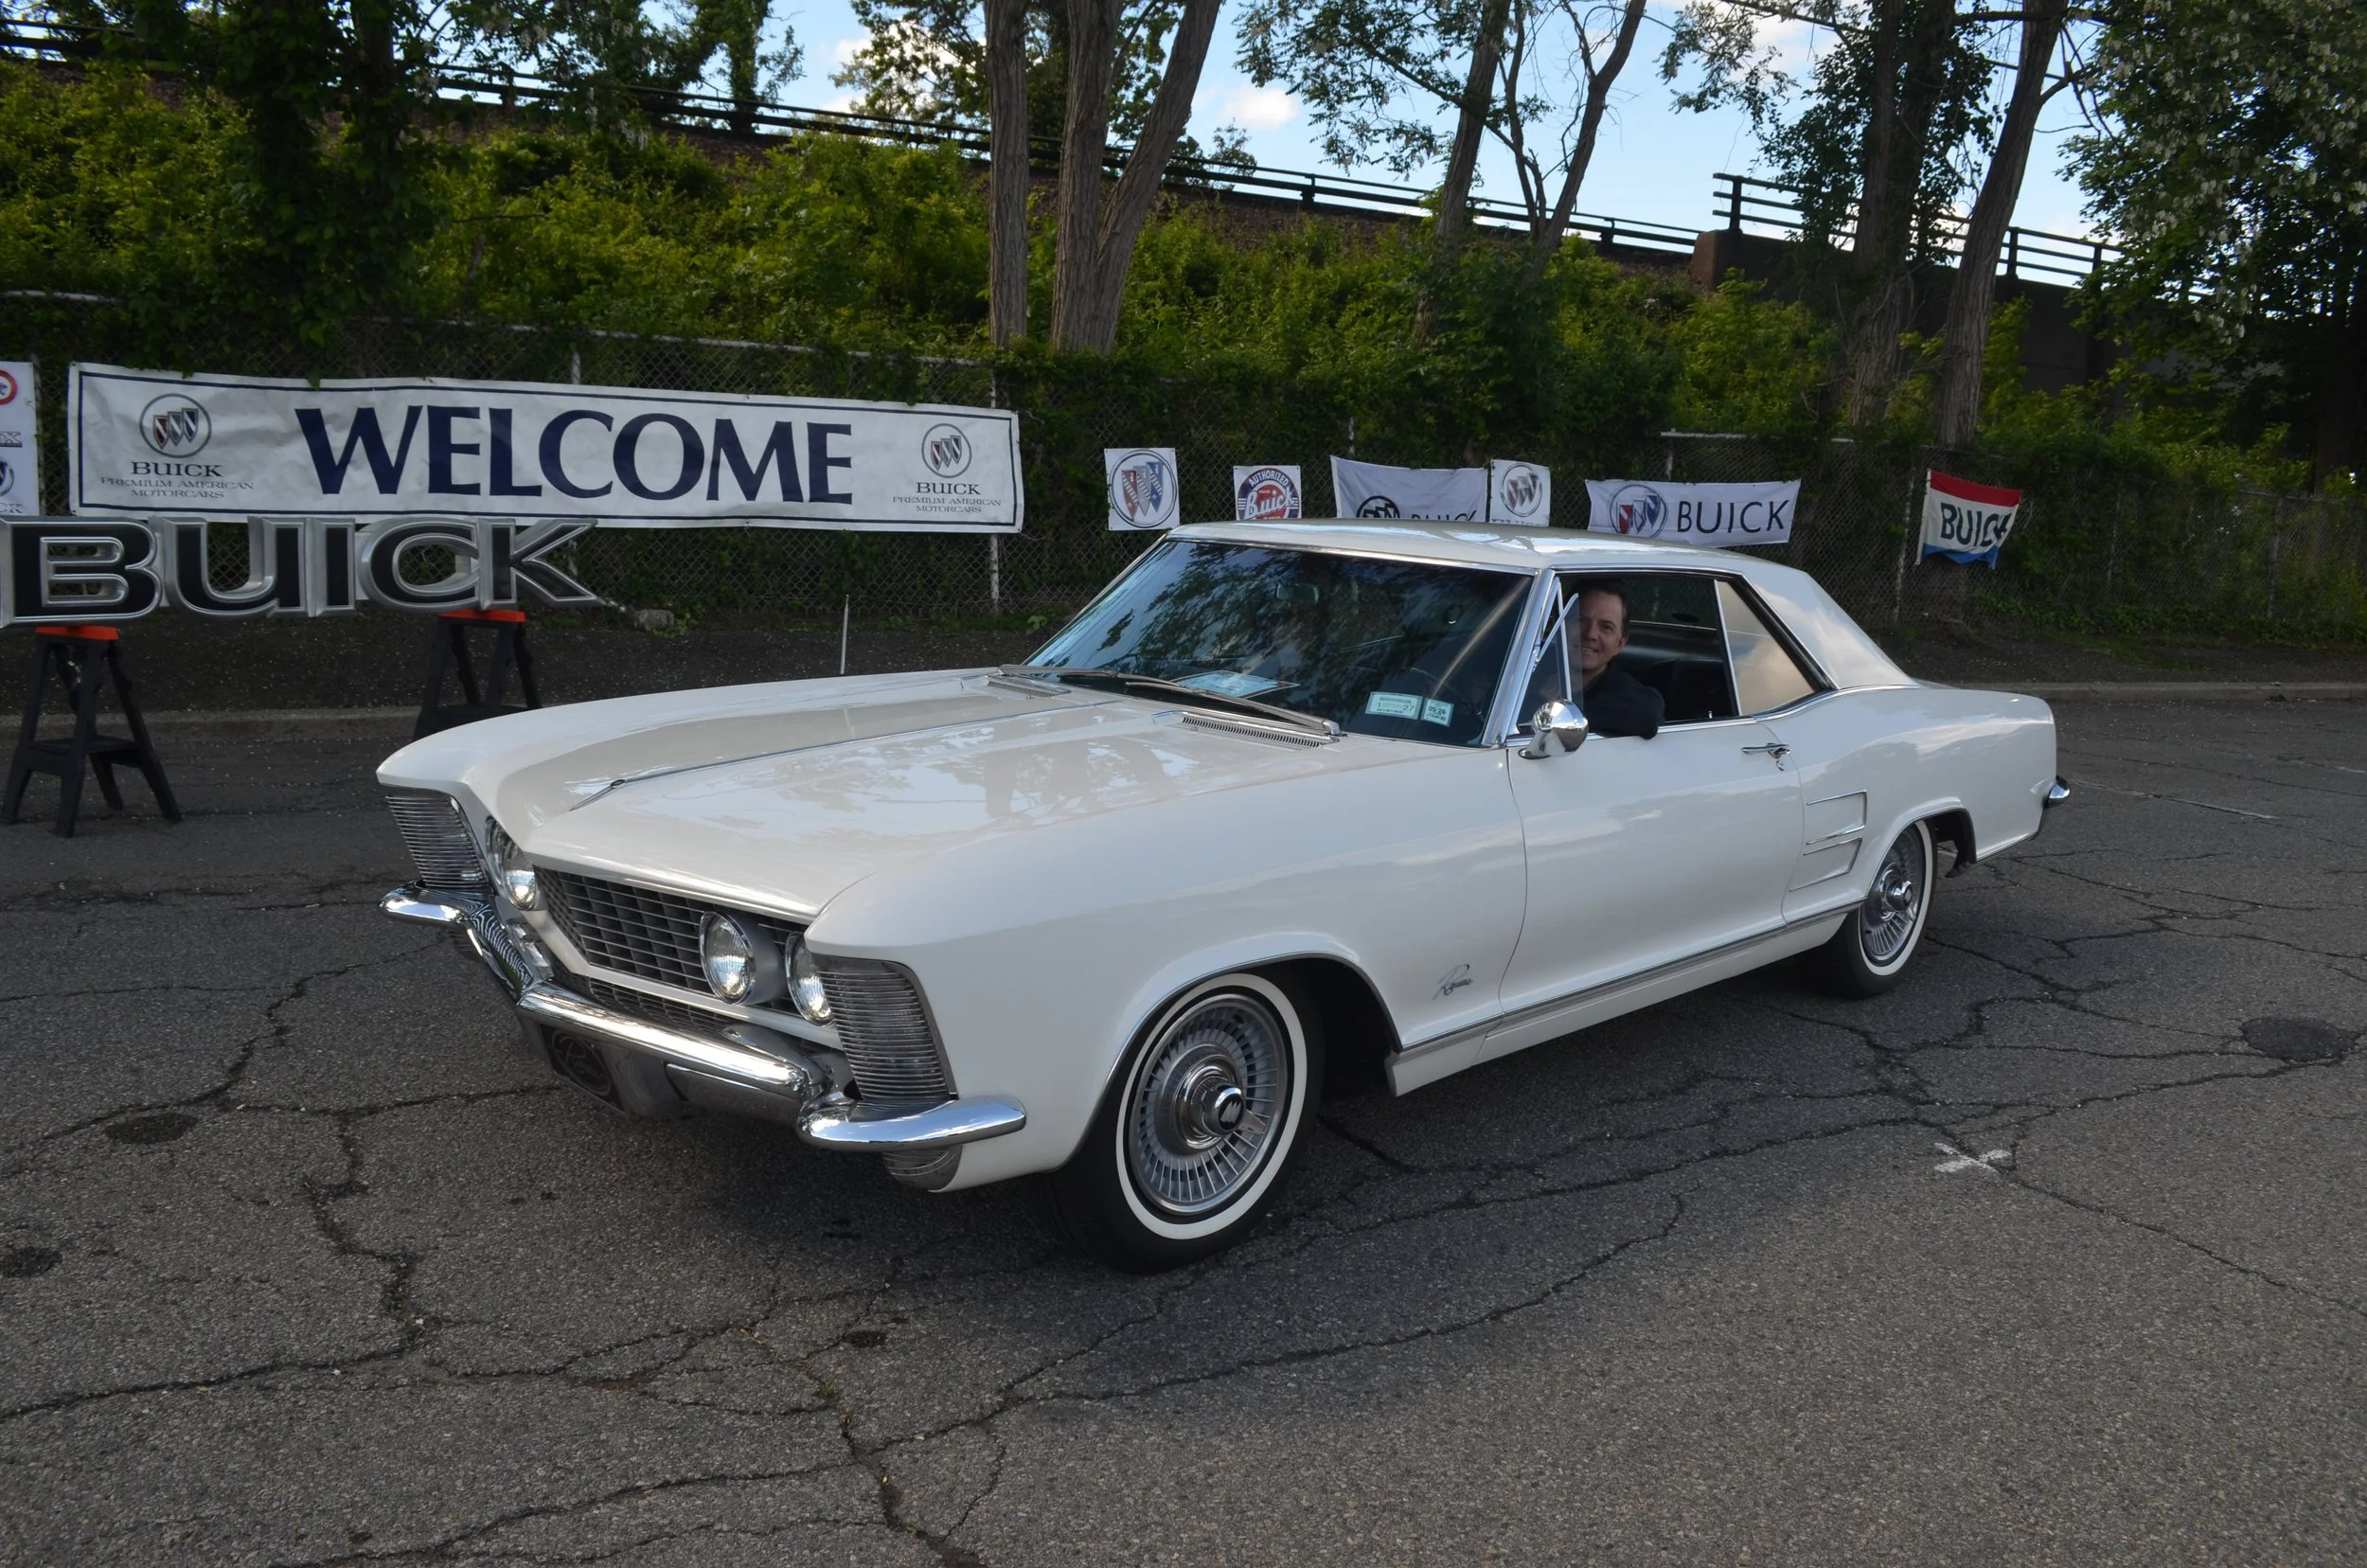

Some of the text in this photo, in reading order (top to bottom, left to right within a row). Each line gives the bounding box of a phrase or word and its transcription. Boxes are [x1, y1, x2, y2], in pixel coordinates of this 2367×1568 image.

[294, 405, 852, 504] WELCOME
[131, 461, 223, 477] BUICK
[100, 476, 255, 490] PREMIUM AMERICAN
[1248, 470, 1290, 488] AUTHORIZED
[131, 490, 224, 499] MOTORCARS
[916, 482, 981, 495] BUICK
[892, 496, 1001, 506] PREMIUM AMERICAN
[916, 505, 982, 513] MOTORCARS
[1244, 485, 1295, 520] Buick
[1677, 499, 1789, 534] BUICK
[0, 515, 611, 629] BUICK
